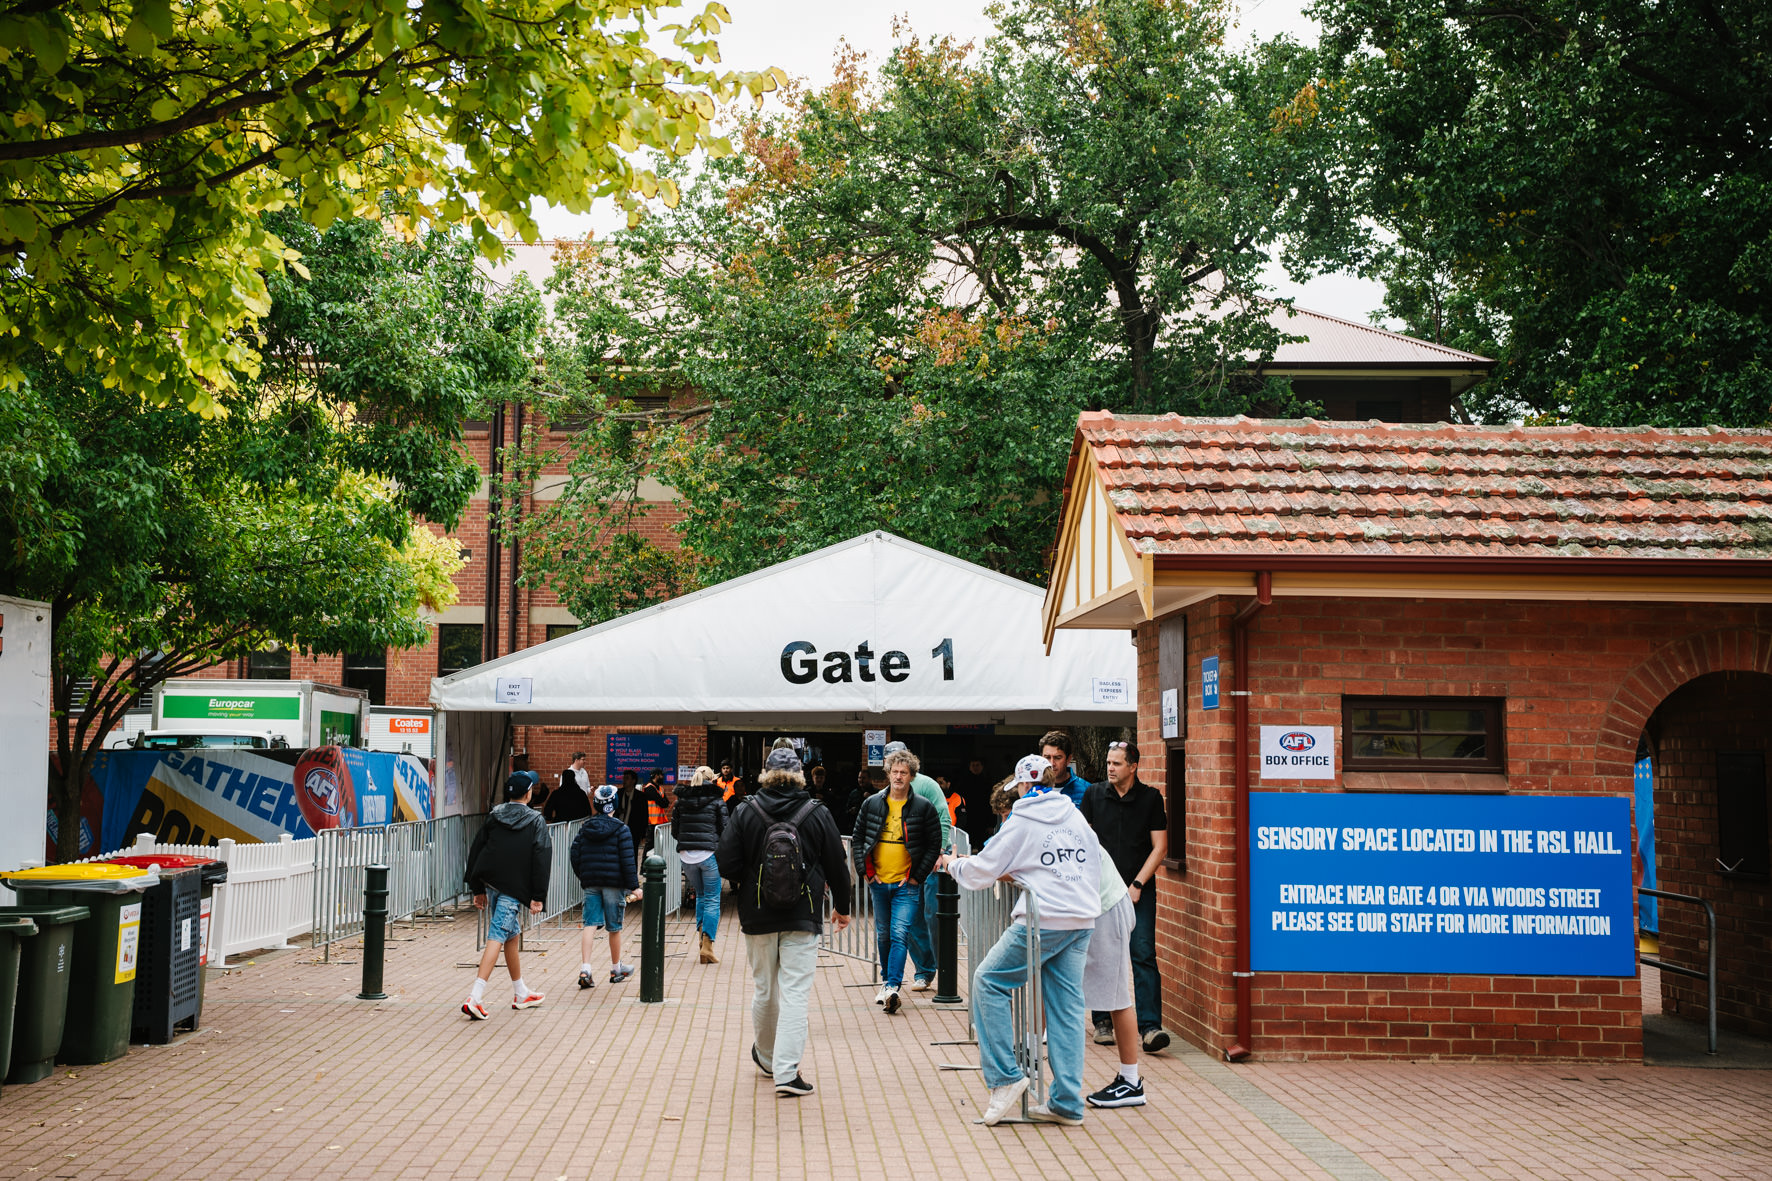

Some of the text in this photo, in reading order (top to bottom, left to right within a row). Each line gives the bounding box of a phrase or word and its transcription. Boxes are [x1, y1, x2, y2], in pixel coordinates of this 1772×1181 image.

[781, 638, 954, 684] Gate 1
[208, 698, 255, 710] Europcar
[394, 718, 424, 728] Coates
[1283, 736, 1313, 748] AFL
[1265, 755, 1329, 766] BOX OFFICE
[305, 773, 338, 812] AFL
[1043, 828, 1073, 848] CLOTHING
[1257, 826, 1622, 854] SENSORY SPACE LOCATED IN THE RSL HALL.
[1040, 848, 1087, 866] ORTC
[1280, 884, 1601, 908] ENTRACE NEAR GATE 4 OR VIA WOODS STREET
[1272, 911, 1611, 936] PLEASE SEE OUR STAFF FOR MORE INFORMATION
